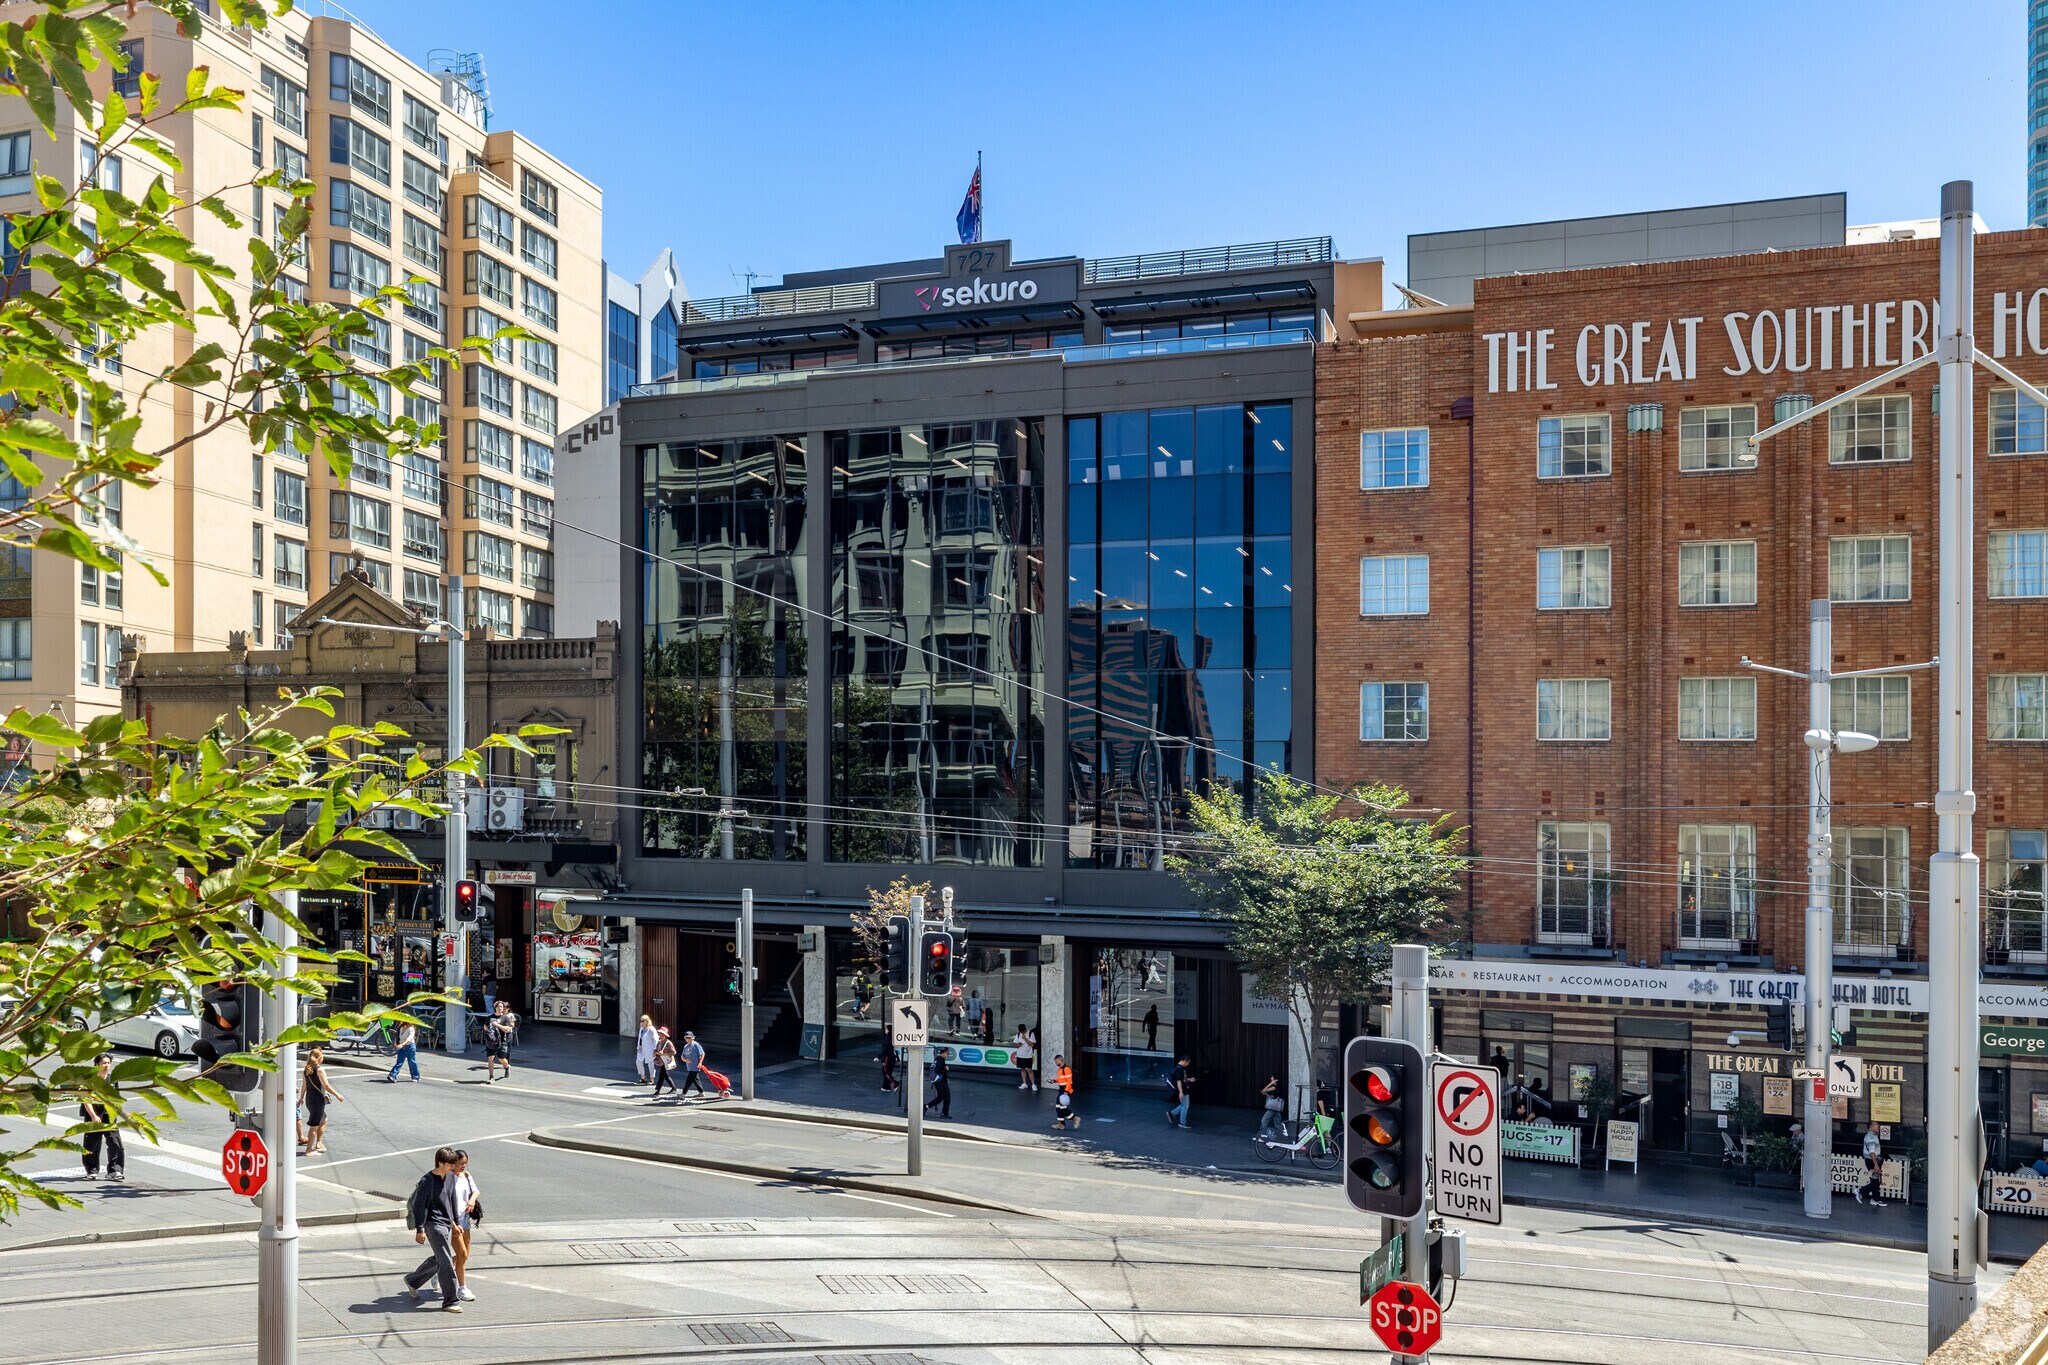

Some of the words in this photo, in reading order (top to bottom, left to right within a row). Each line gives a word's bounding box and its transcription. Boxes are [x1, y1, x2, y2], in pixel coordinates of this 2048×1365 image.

[957, 250, 995, 273] 727
[941, 277, 1038, 307] sekuro
[1482, 329, 1557, 393] THE
[1576, 317, 1703, 387] GREAT
[1473, 971, 1541, 983] RESTAURANT
[1560, 975, 1668, 990] ACCOMMODATION
[1730, 979, 1753, 998] THE
[1758, 980, 1799, 1001] GREAT
[1871, 985, 1912, 1006] HOTEL
[896, 1033, 924, 1042] ONLY
[1983, 1032, 2046, 1052] George
[1707, 1054, 1733, 1071] THE
[1736, 1056, 1780, 1074] GREAT
[1862, 1063, 1907, 1082] HOTEL
[1716, 1080, 1733, 1090] $18
[1831, 1084, 1858, 1093] ONLY
[1543, 1135, 1564, 1146] $17
[1610, 1128, 1635, 1136] HAPPY
[1611, 1134, 1633, 1142] HOUR
[225, 1149, 267, 1178] STOP
[1449, 1141, 1484, 1166] NO
[1441, 1169, 1493, 1192] RIGHT
[1831, 1165, 1862, 1176] APPY
[1444, 1191, 1492, 1214] TURN
[1996, 1186, 2032, 1204] $20
[1375, 1300, 1438, 1335] STOP
